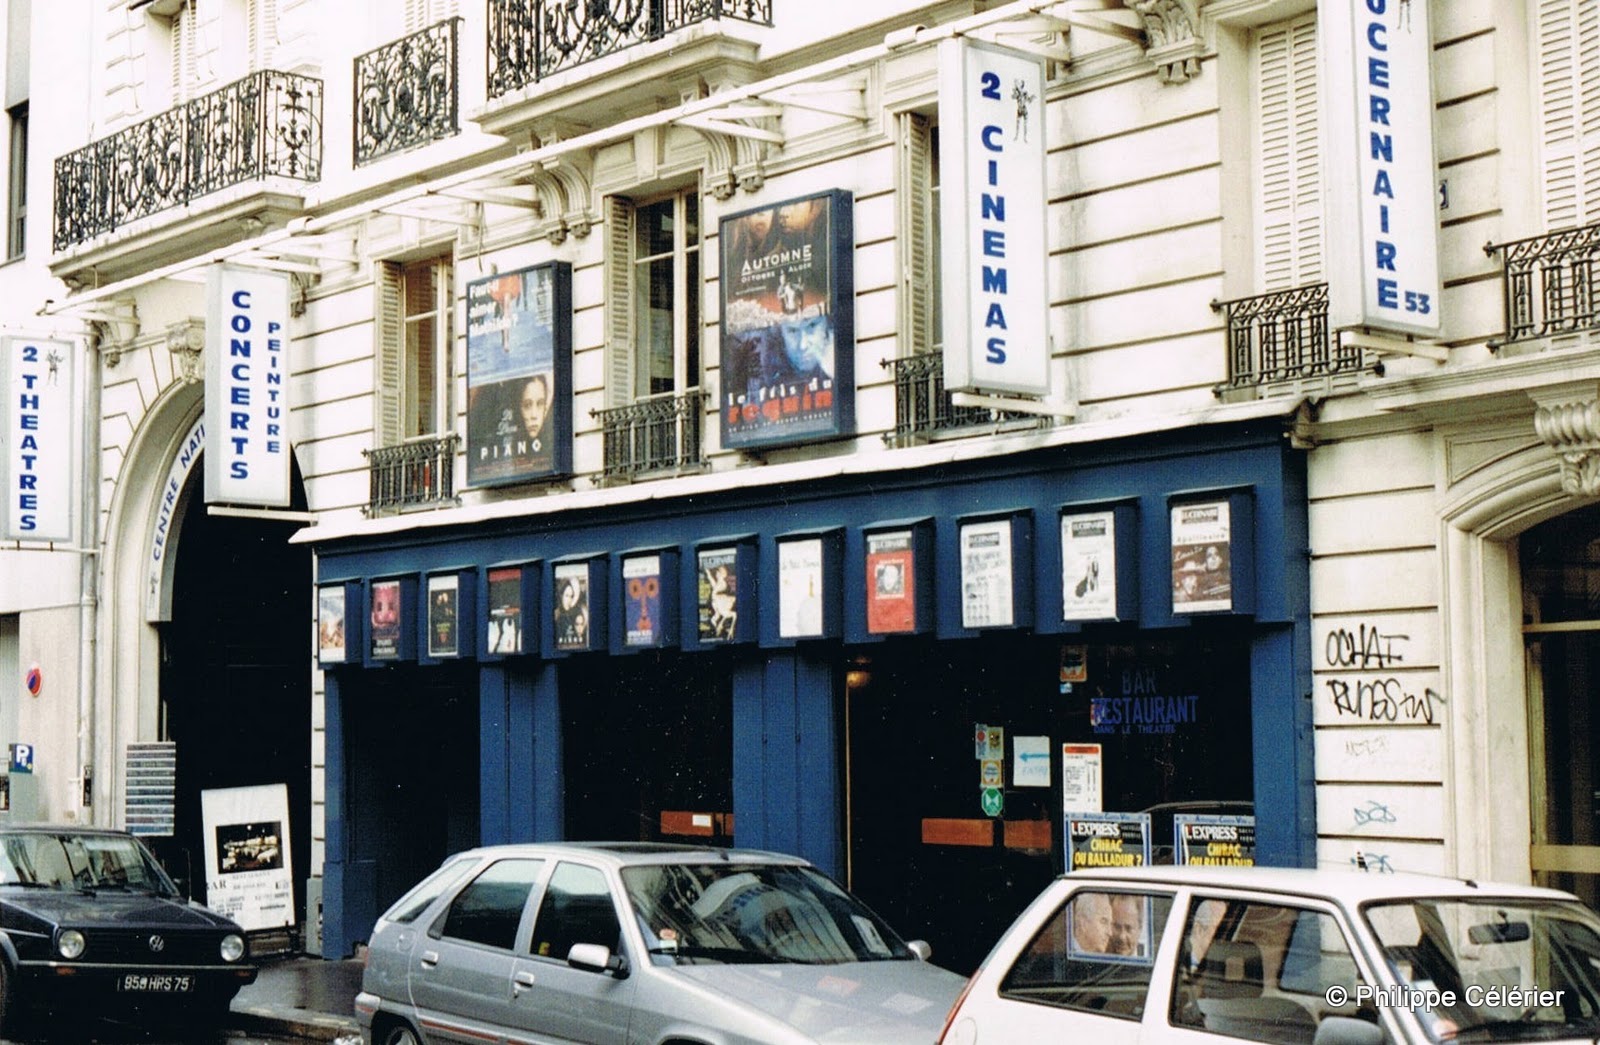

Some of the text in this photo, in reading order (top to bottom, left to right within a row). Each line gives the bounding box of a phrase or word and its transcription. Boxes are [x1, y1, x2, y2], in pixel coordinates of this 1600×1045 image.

[980, 71, 1008, 365] 2 CINEMAS
[741, 243, 812, 277] AUTOMNE
[1404, 290, 1431, 315] 53
[22, 346, 39, 363] 2
[230, 290, 252, 480] CONCERTS
[267, 321, 281, 454] PEINTURE
[19, 374, 39, 531] THEATRES
[481, 439, 542, 460] PIANO
[153, 477, 179, 561] CENTRE
[1121, 669, 1157, 695] BAR
[1093, 695, 1199, 725] RESTAURANT
[16, 745, 30, 764] P
[1090, 838, 1123, 853] CHIRAC
[1207, 842, 1242, 857] CHIRAC
[1074, 851, 1087, 865] OU
[1087, 852, 1135, 867] BALLADUR
[148, 976, 172, 991] HRS
[174, 977, 190, 991] 75
